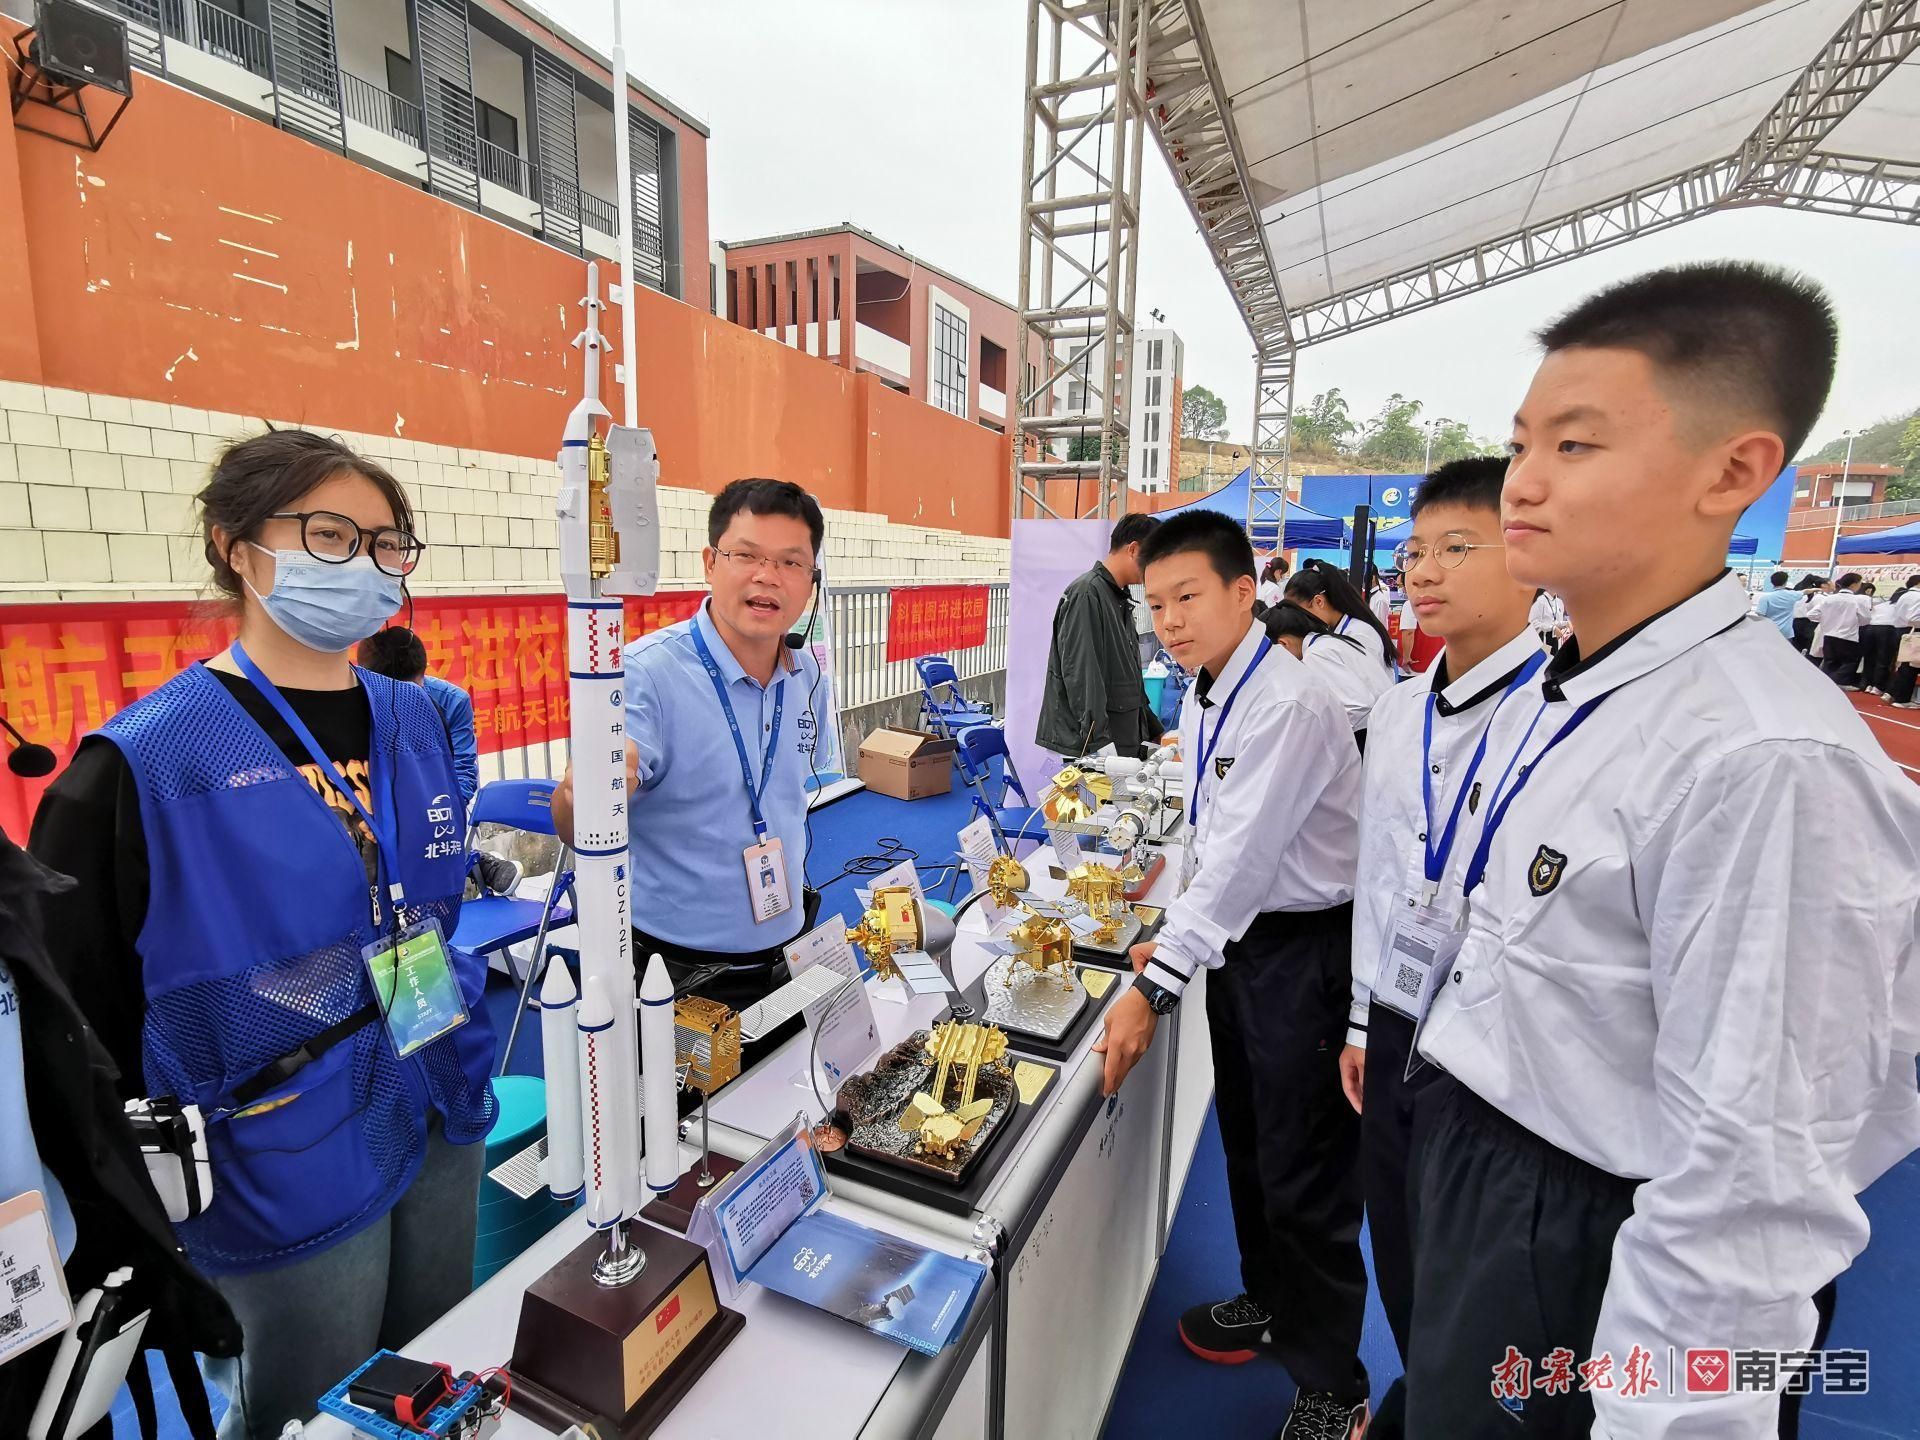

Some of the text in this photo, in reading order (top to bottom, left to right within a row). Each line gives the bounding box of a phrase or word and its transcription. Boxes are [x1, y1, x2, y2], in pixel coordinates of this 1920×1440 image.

[896, 597, 984, 625] 科普图书进校园
[610, 722, 625, 817] 中国航天
[404, 965, 428, 1010] 工作人员
